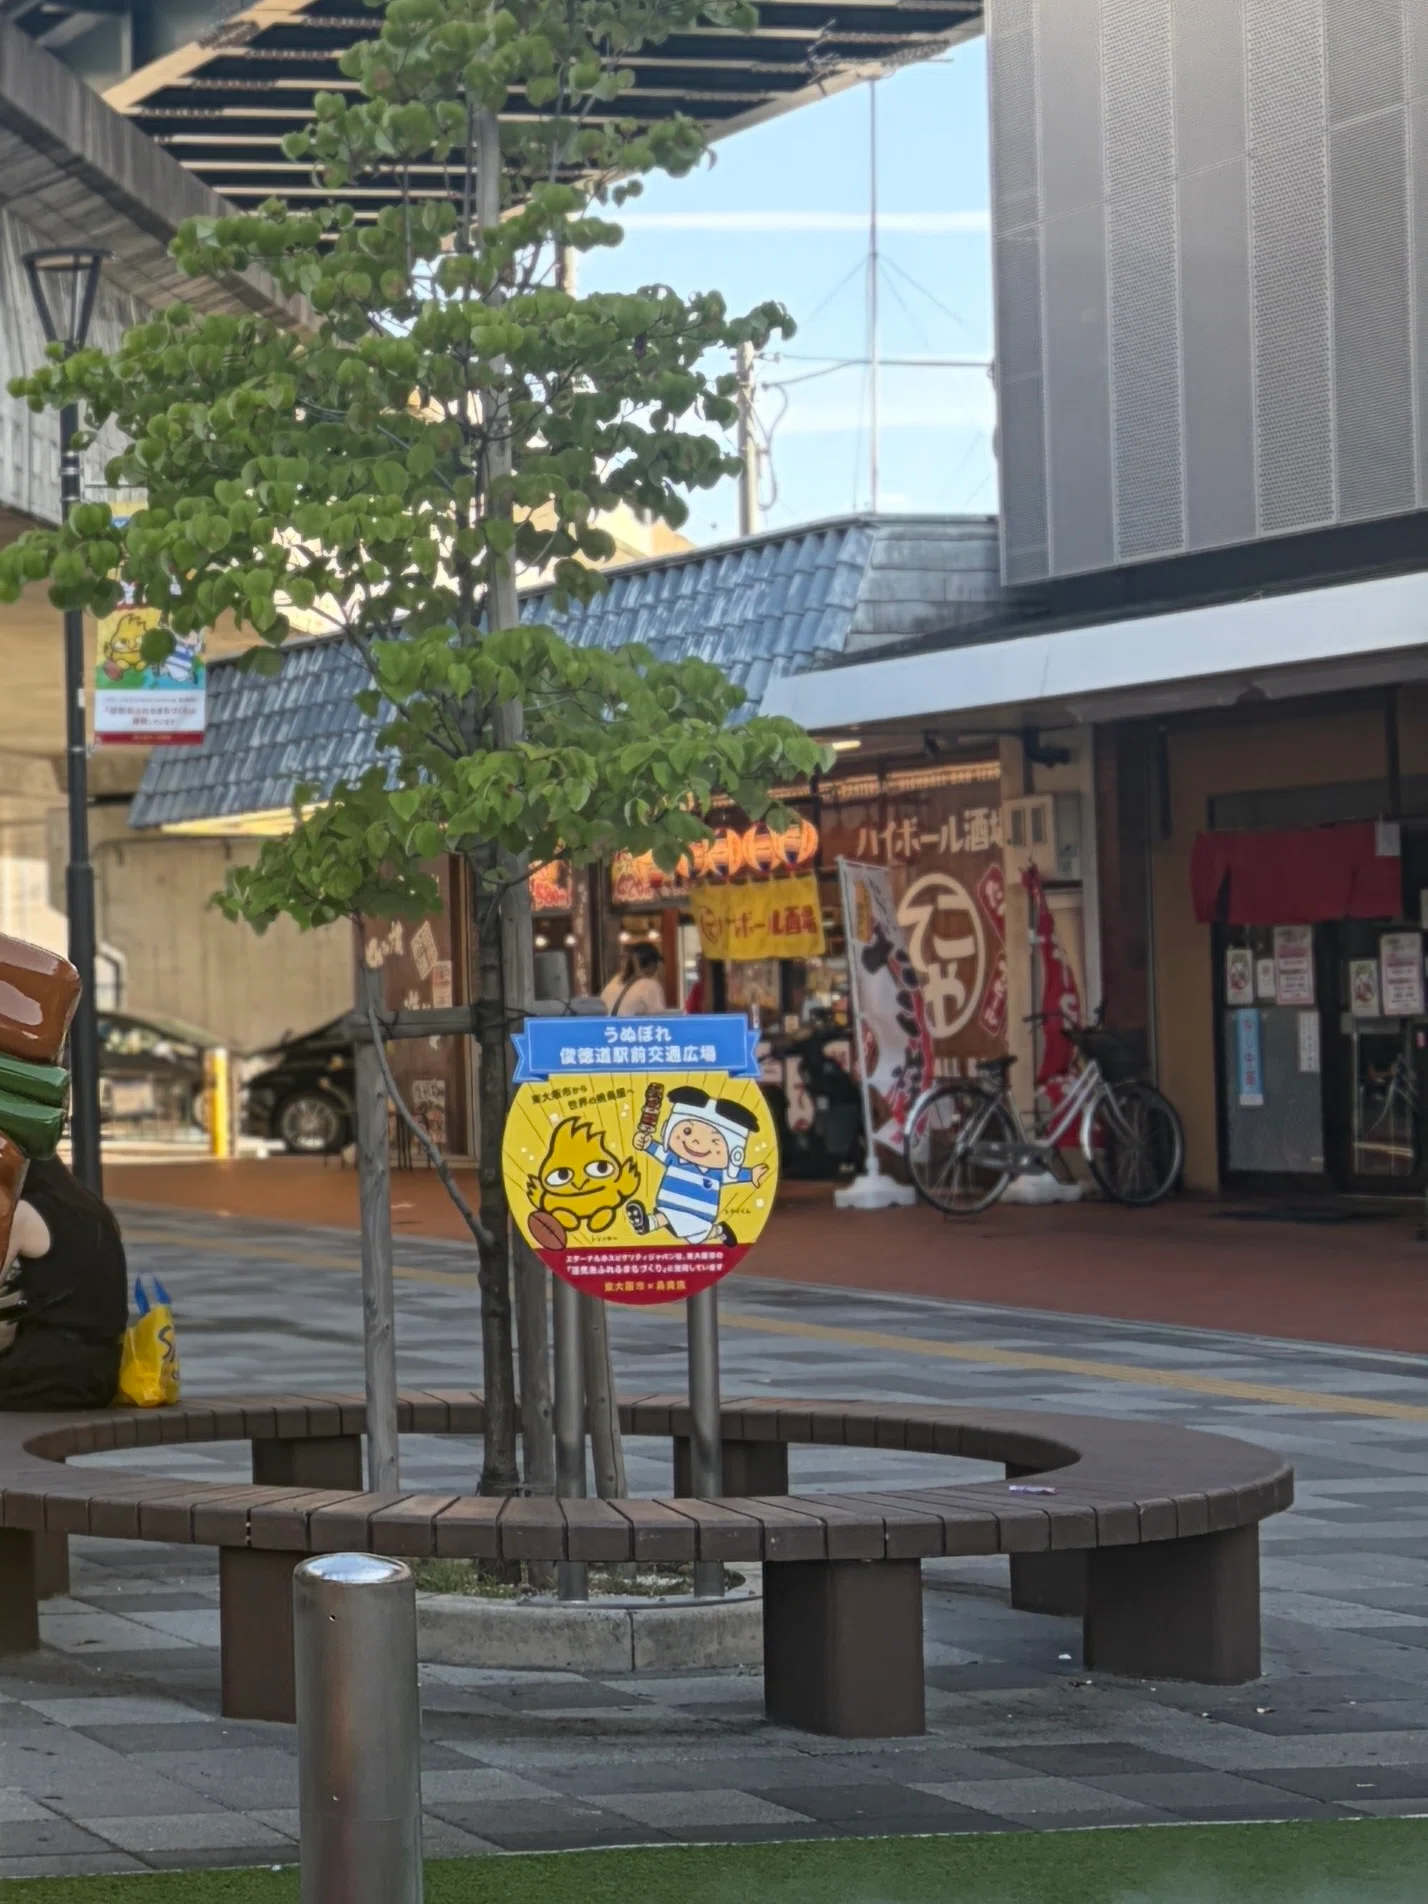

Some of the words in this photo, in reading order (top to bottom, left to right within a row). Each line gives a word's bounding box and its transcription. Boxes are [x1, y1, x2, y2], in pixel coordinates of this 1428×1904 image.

[603, 1025, 673, 1044] うぬぼれ
[559, 1044, 717, 1065] 俊徳道駅前交通広場
